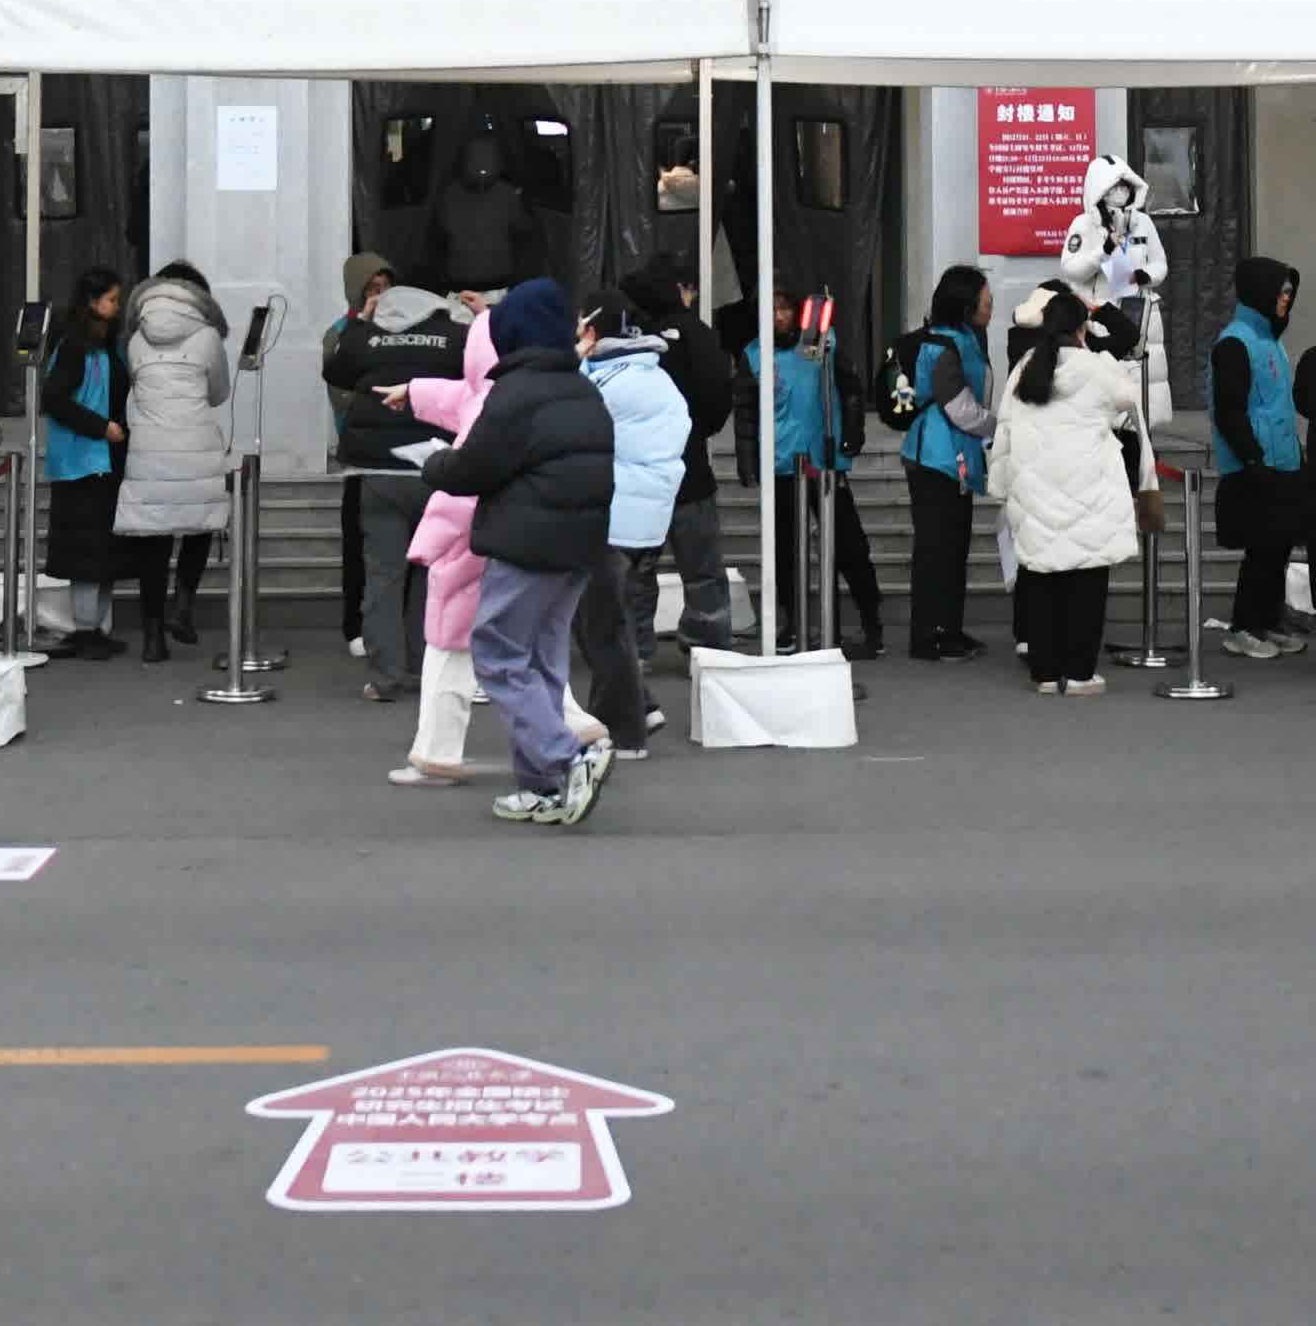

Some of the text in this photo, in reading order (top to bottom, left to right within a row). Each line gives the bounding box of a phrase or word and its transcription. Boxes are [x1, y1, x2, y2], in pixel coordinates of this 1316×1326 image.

[996, 104, 1075, 122] 封楼通知
[381, 334, 447, 348] DESCENTE
